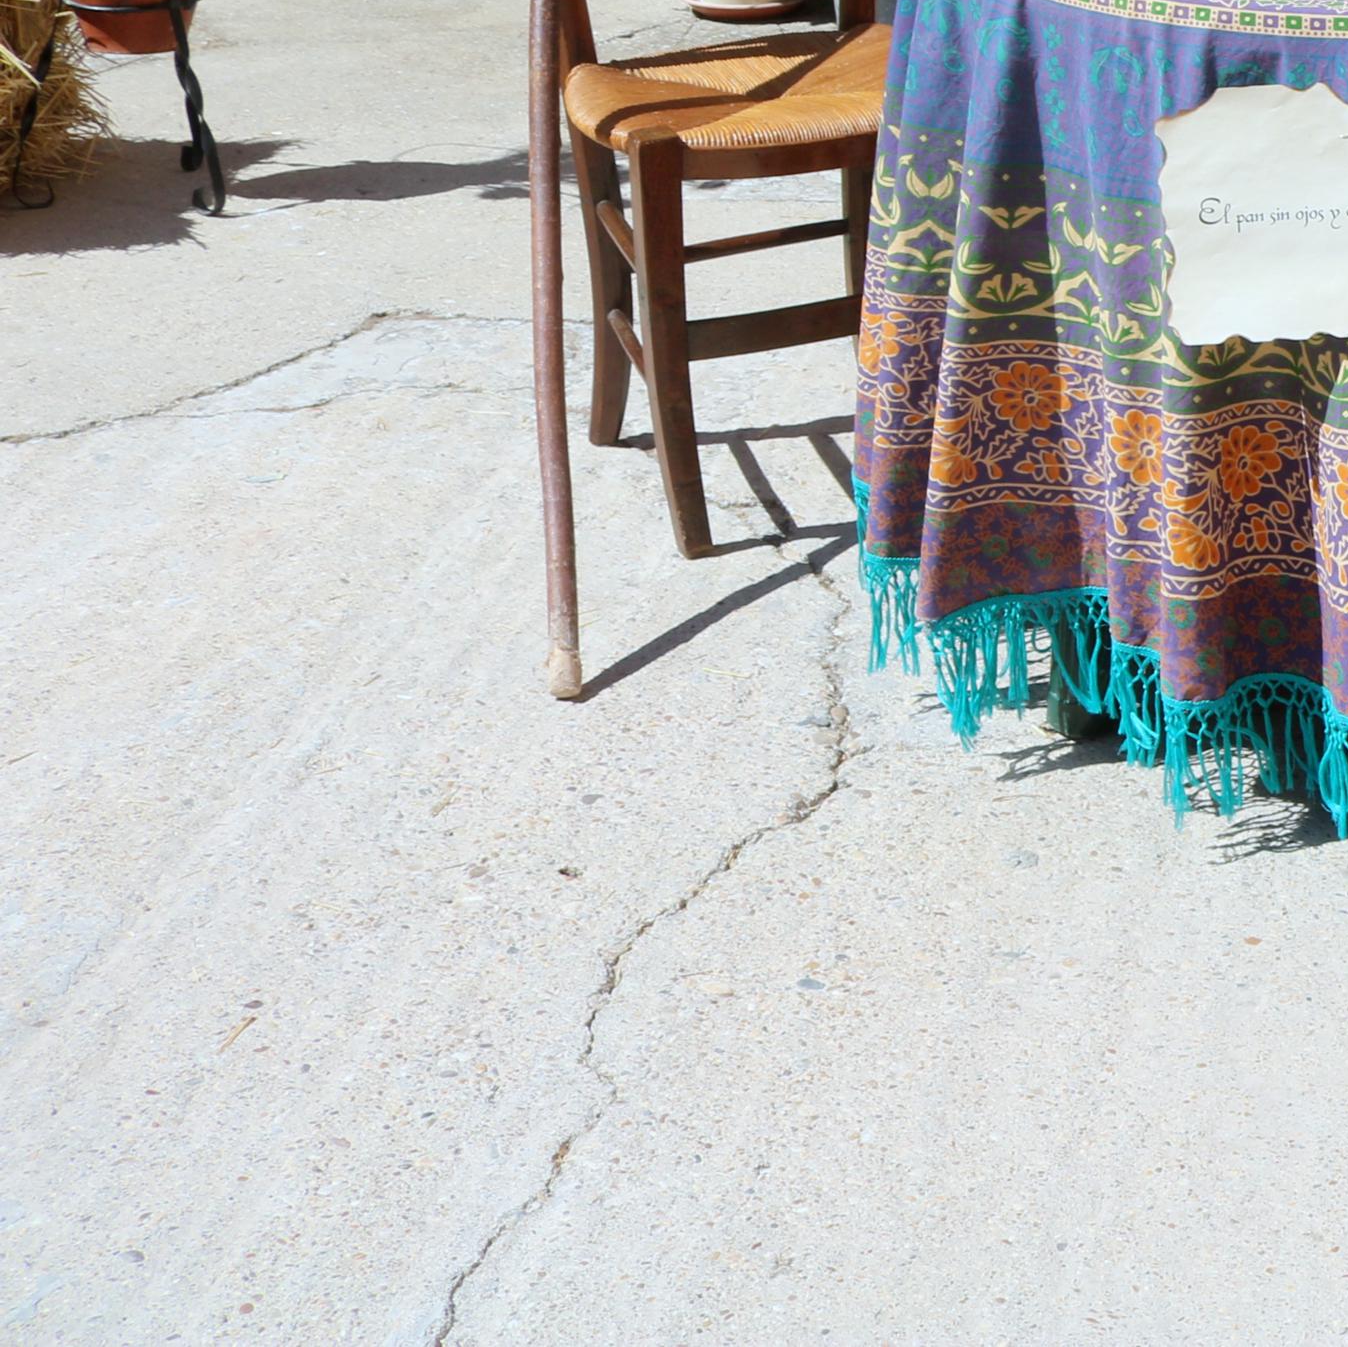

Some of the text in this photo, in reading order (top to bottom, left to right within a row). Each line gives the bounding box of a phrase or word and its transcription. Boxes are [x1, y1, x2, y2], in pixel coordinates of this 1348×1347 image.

[1199, 196, 1232, 225] El
[1236, 211, 1264, 233] pan
[1270, 207, 1290, 225] sin
[1295, 205, 1325, 227] ojos
[1330, 207, 1341, 229] y
